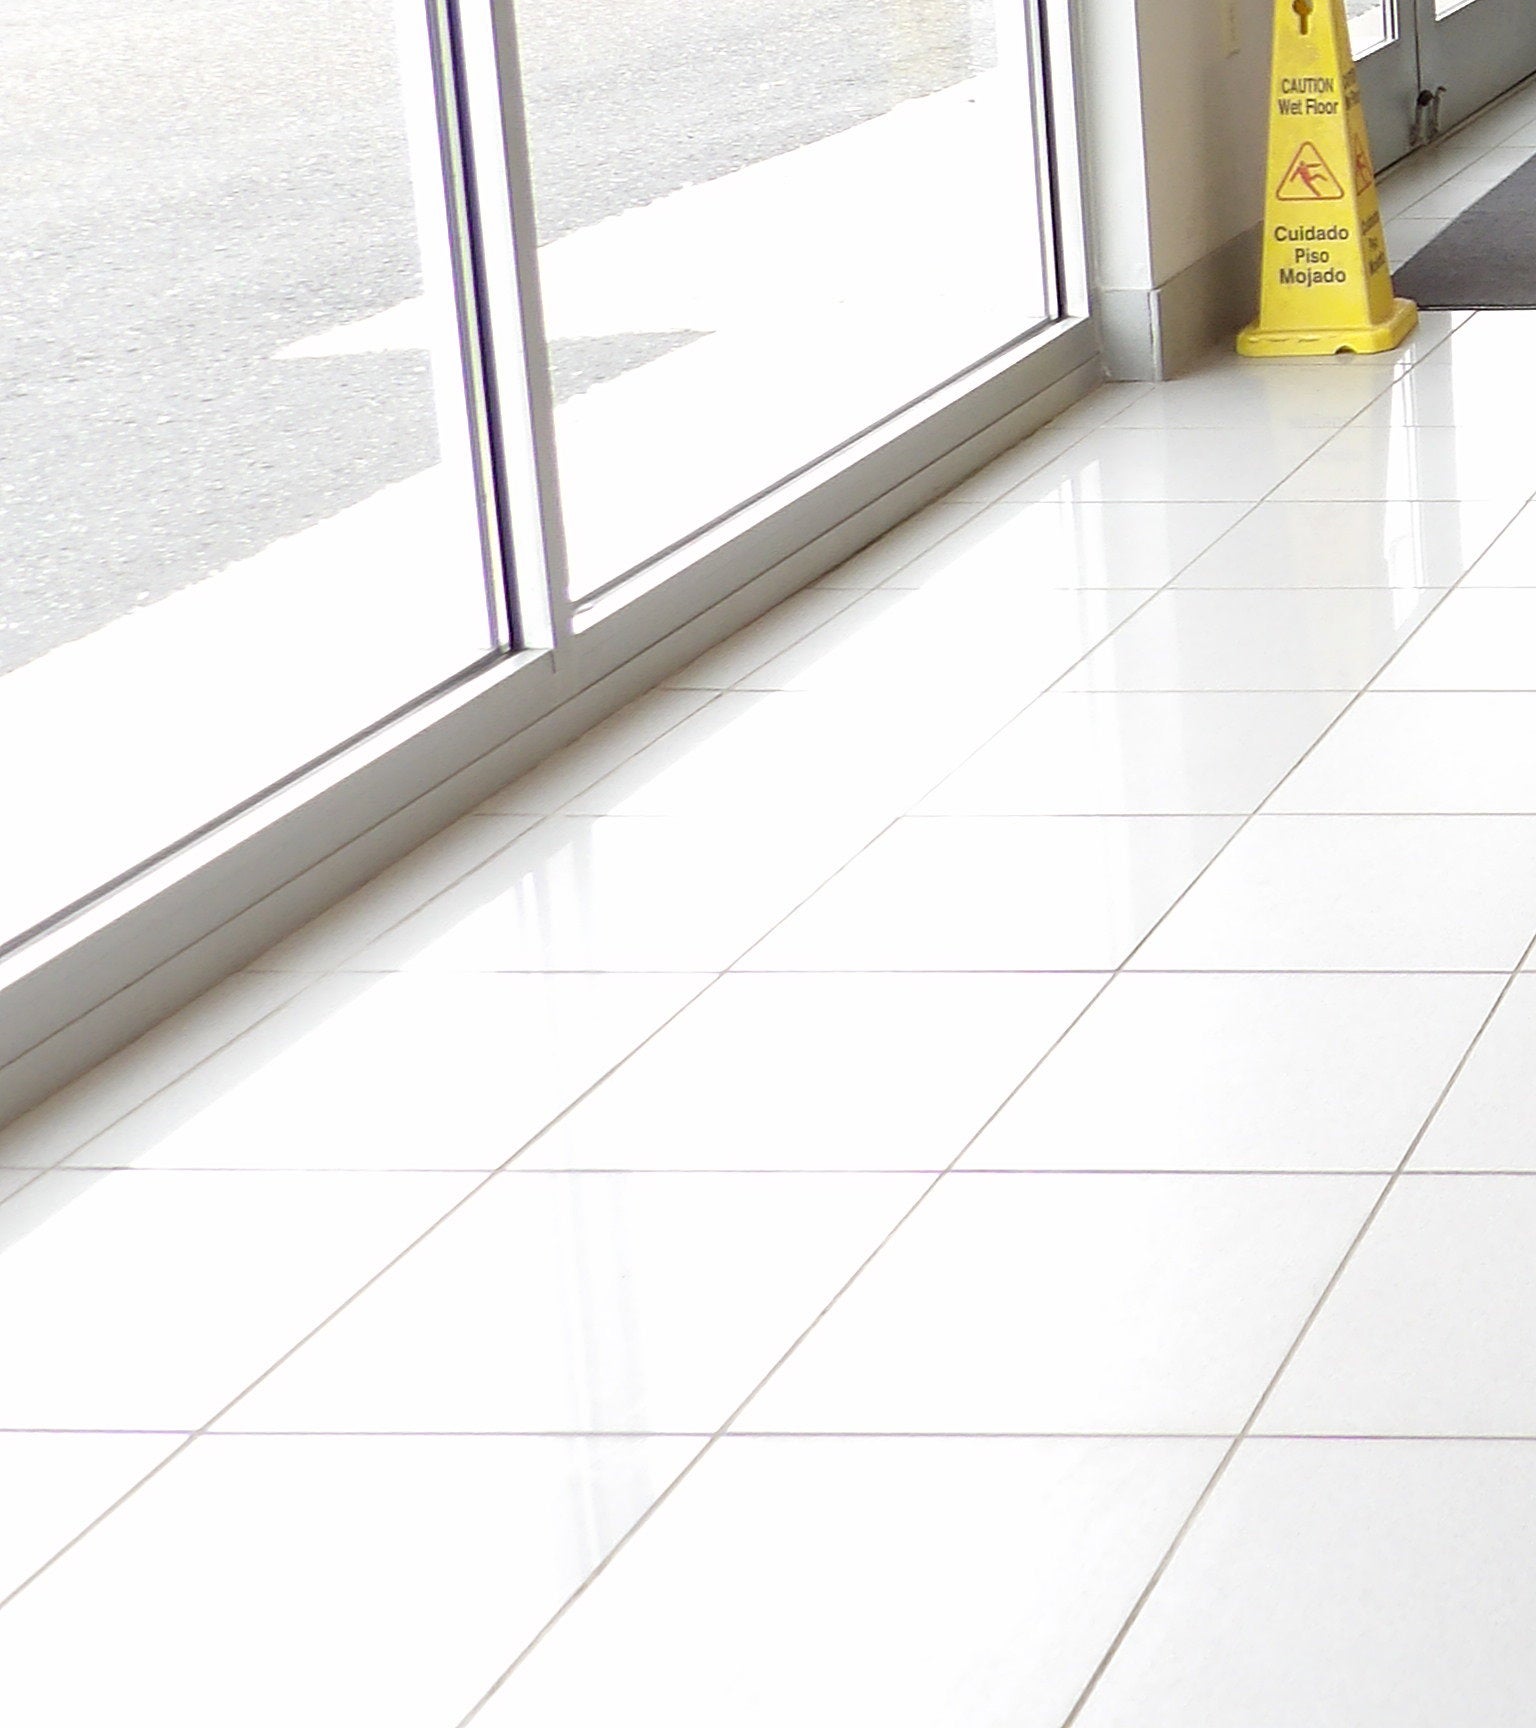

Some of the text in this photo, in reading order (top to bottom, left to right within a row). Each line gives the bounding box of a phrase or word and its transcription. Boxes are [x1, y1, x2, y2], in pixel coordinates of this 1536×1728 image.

[1281, 77, 1334, 94] CAUTION
[1278, 98, 1303, 115] Wet
[1306, 98, 1339, 115] Floor
[1274, 225, 1349, 241] Cuidado
[1295, 248, 1330, 263] Piso
[1280, 267, 1346, 287] Mojado
